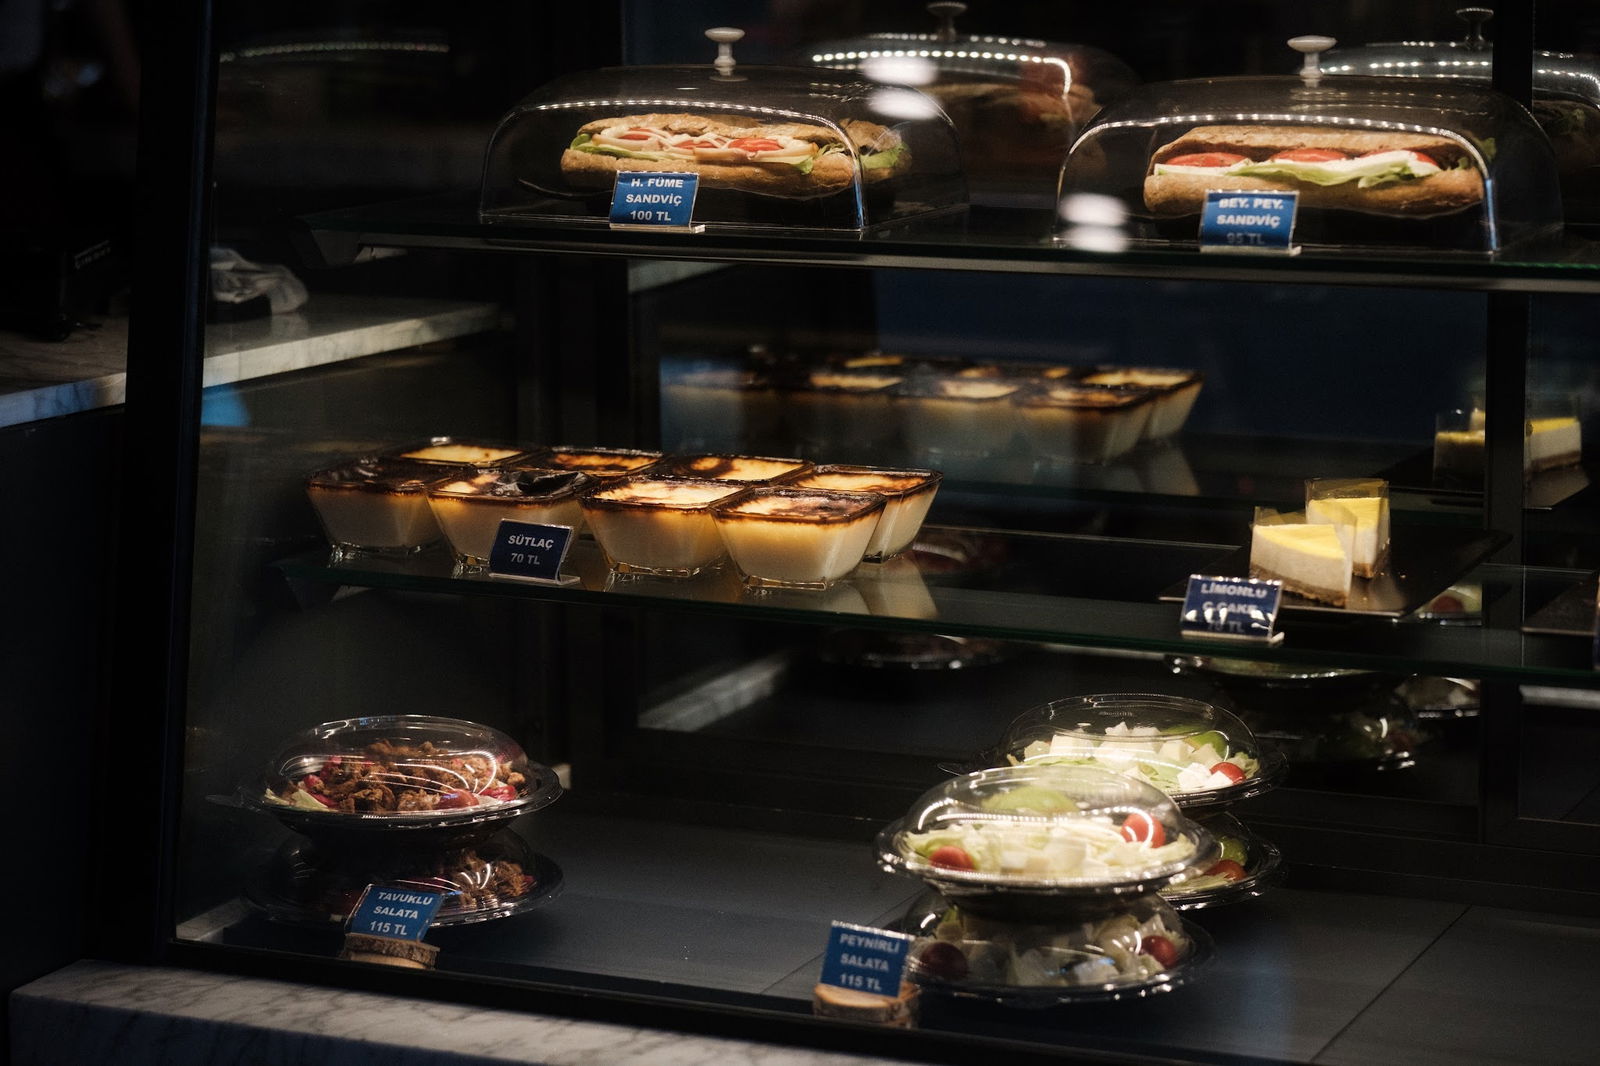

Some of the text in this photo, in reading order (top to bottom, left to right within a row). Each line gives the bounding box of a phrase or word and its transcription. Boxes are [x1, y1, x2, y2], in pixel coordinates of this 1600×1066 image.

[631, 177, 684, 188] H. FÜME
[626, 193, 682, 206] SANDVİÇ
[1218, 197, 1284, 209] BEY. PEY.
[630, 210, 671, 220] 100 TL
[1216, 214, 1280, 229] SANDVİÇ
[1247, 232, 1265, 244] TL
[508, 534, 554, 550] SÜTLAÇ
[511, 553, 540, 564] 70 TL
[1200, 582, 1267, 598] LİMONLU
[378, 892, 433, 905] TAVUKLU
[373, 906, 418, 919] SALATA
[370, 921, 407, 935] 115 TL
[840, 933, 900, 953] PEYNİRLİ
[840, 953, 888, 972] SALATA
[840, 973, 881, 991] 115 TL
